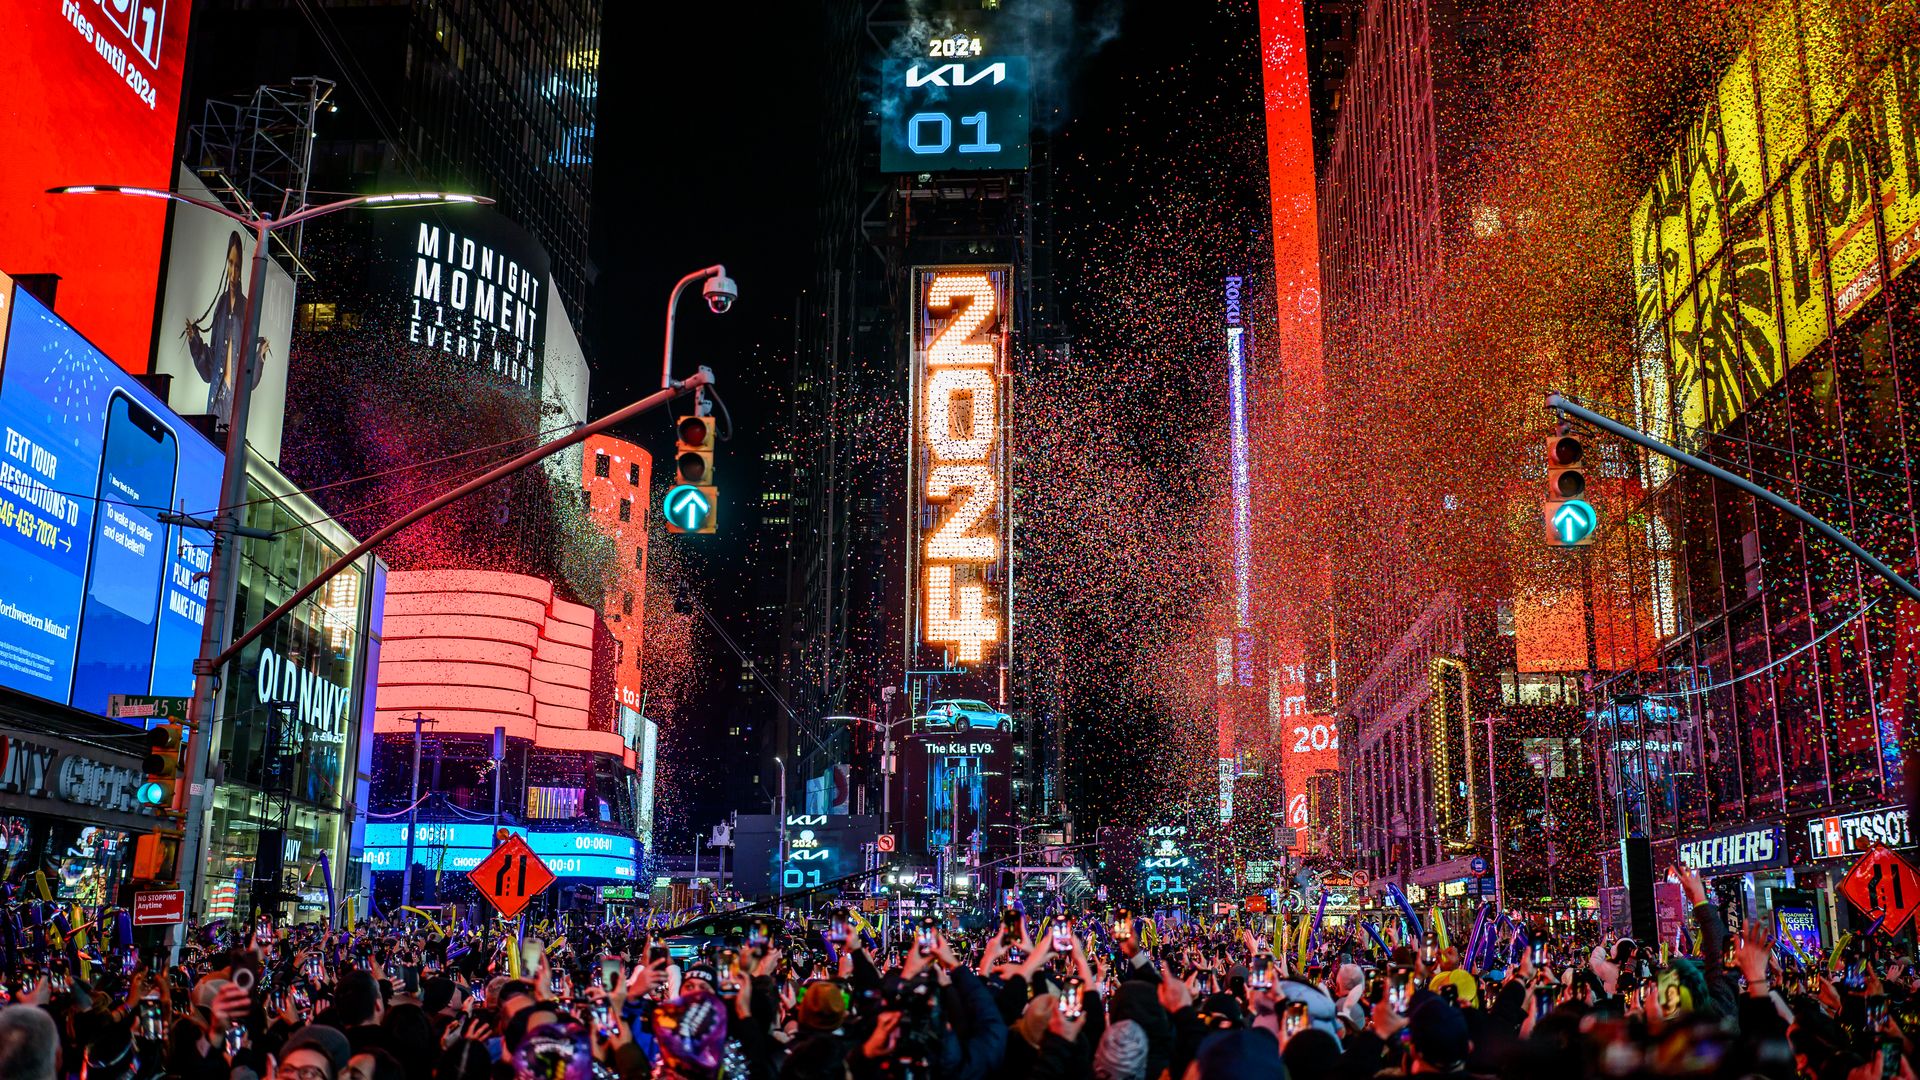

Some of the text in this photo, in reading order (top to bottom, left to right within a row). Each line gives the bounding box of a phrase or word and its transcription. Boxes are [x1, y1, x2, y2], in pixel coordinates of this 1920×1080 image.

[929, 38, 982, 57] 2024
[95, 32, 127, 78] until
[126, 62, 157, 111] 2024
[906, 62, 1006, 88] KIA
[908, 111, 1001, 154] 01
[417, 222, 539, 309] MIDNIGHT
[413, 257, 537, 348] MOMENT
[411, 299, 534, 372] 11:57 PM
[409, 320, 534, 391] EVERY NIGHT
[5, 426, 58, 481] TEXT YOUR
[927, 274, 997, 662] 2024
[0, 460, 79, 528] RESOLUTIONS TO
[103, 525, 116, 540] and
[115, 532, 125, 546] eat
[107, 502, 154, 542] To wake up earlier
[195, 544, 209, 572] GOT
[172, 562, 190, 590] PLAN
[169, 589, 189, 616] MAKE
[188, 598, 196, 621] IT
[257, 647, 346, 736] OLD NAVY
[152, 699, 169, 717] 45
[176, 700, 187, 712] St
[925, 743, 995, 754] The Kia EV9.
[575, 836, 613, 851] 00:00:01
[792, 839, 819, 848] 2024
[1842, 811, 1911, 851] TISSOT
[1680, 828, 1774, 870] SKECHERS
[783, 868, 823, 889] 01
[1146, 875, 1188, 894] 01
[137, 893, 177, 903] NO STOPPING
[137, 902, 163, 911] Anytime
[1782, 923, 1816, 932] ARTY!
